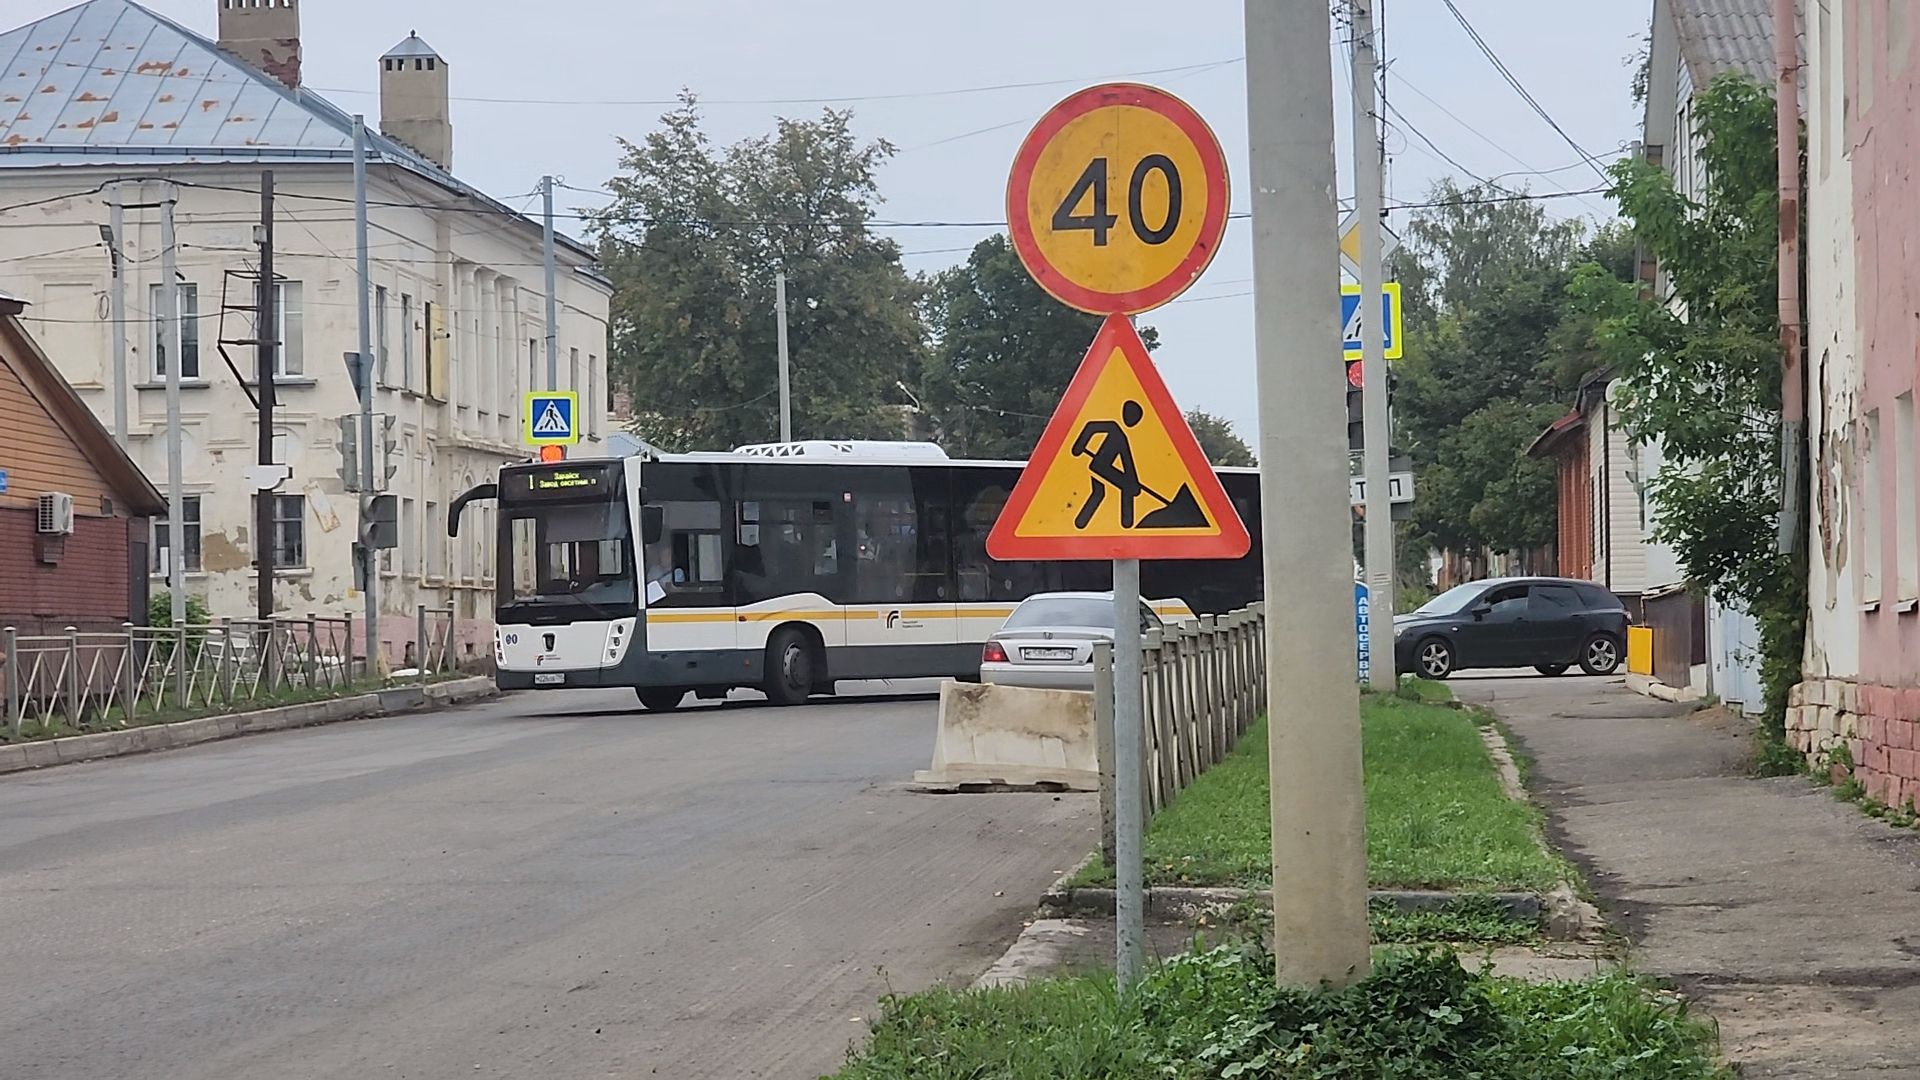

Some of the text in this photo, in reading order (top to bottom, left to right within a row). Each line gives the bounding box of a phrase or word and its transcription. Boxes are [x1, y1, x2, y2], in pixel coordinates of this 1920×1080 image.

[1052, 154, 1182, 246] 40
[529, 474, 534, 490] 1
[1349, 479, 1402, 499] ТП
